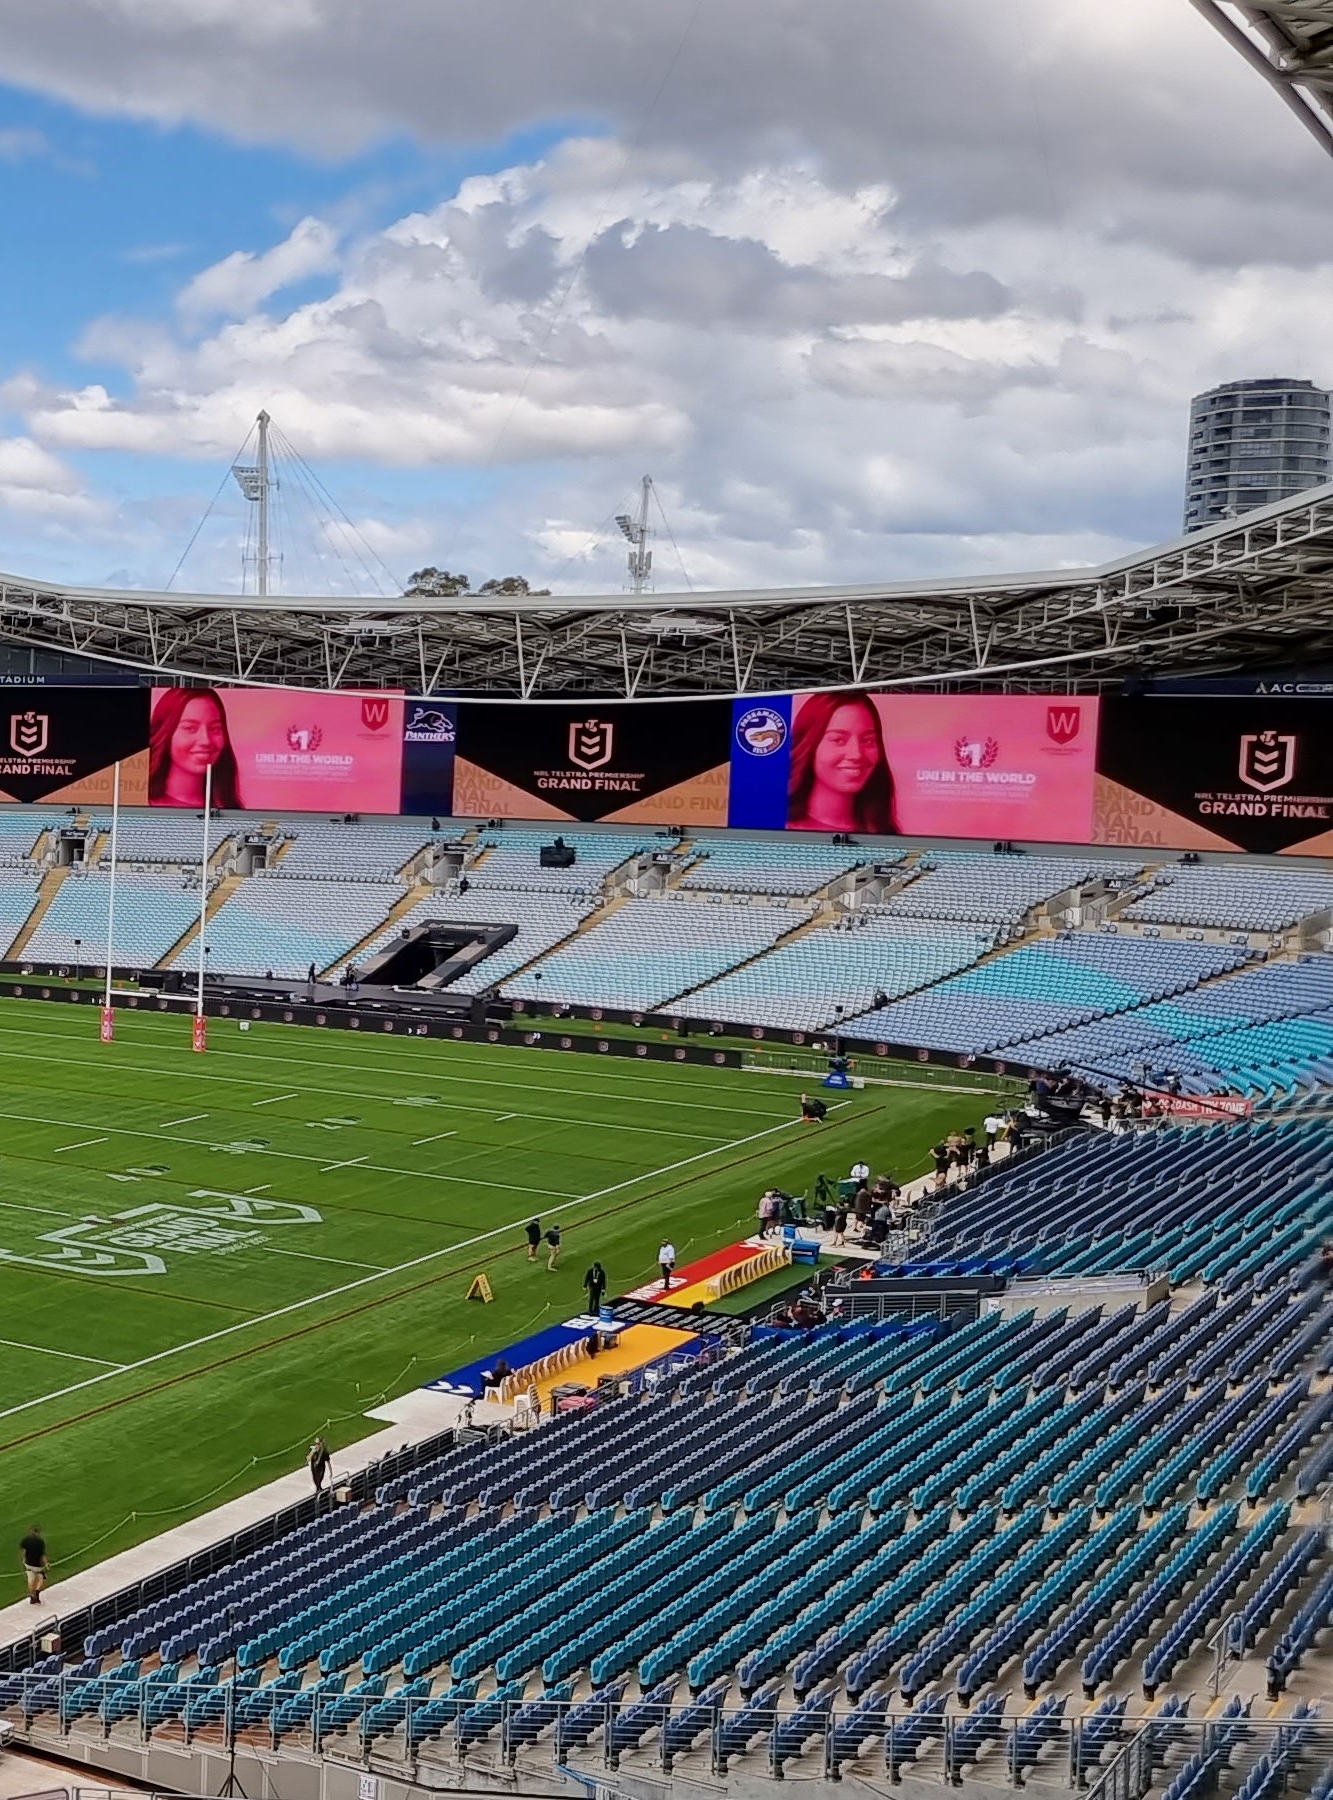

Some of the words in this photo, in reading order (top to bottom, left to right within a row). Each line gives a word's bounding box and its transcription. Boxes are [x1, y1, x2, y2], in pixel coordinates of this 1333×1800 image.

[1049, 712, 1077, 735] W
[404, 731, 456, 742] PANTHERS
[313, 755, 354, 765] WORLD
[33, 764, 73, 776] FINAL
[551, 770, 587, 778] TELSTRA
[916, 770, 939, 781] UNI
[958, 771, 983, 783] THE
[985, 772, 1036, 784] WORLD
[537, 777, 592, 790] GRAND
[595, 778, 641, 791] FINAL
[1194, 792, 1213, 800] NRL
[1216, 792, 1261, 802] TELSTRA
[1198, 801, 1269, 816] GRAND
[1270, 802, 1330, 819] FINAL
[1105, 829, 1169, 846] FINAL
[108, 1216, 220, 1248] GRAND
[155, 1227, 263, 1255] FINAL
